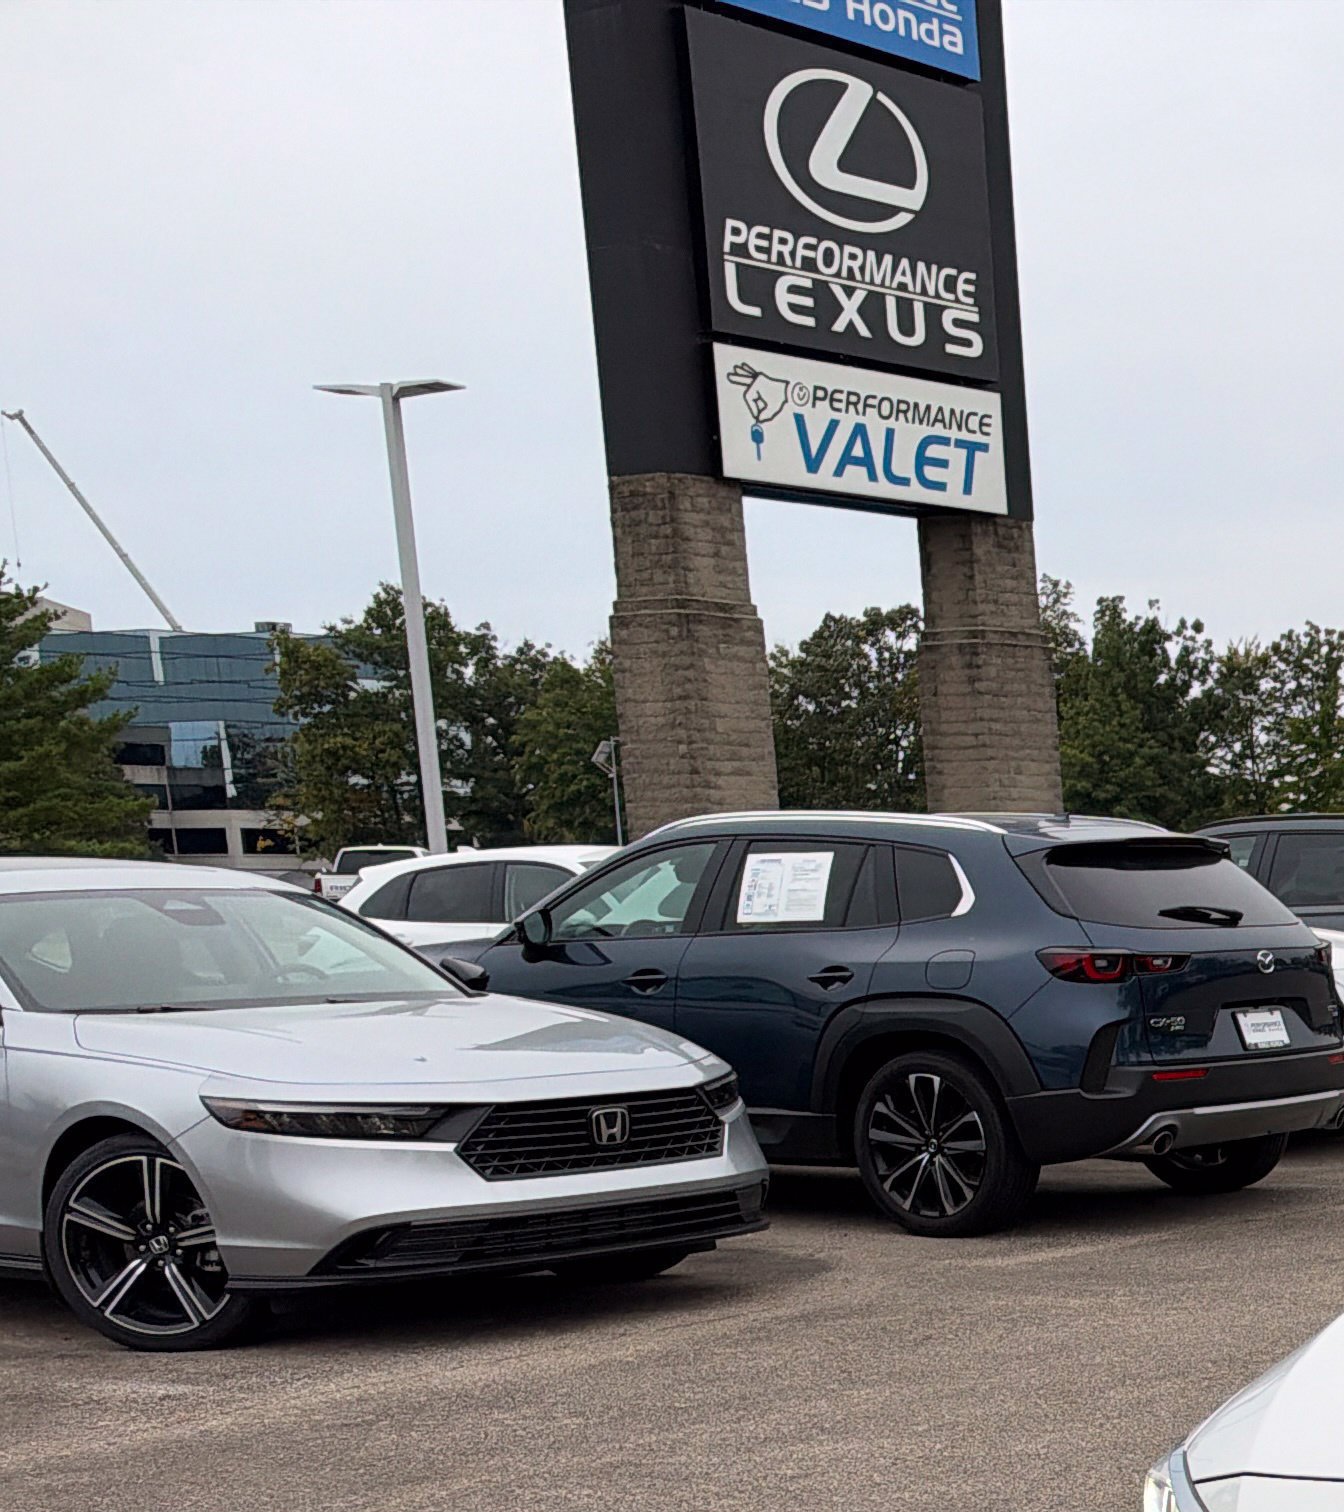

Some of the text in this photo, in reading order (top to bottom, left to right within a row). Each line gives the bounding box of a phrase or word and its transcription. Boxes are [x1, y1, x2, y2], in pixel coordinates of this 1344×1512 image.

[846, 0, 965, 56] Honda
[723, 217, 978, 305] PERFORMANCE
[723, 260, 984, 358] LEXUS
[811, 384, 993, 437] PERFORMANCE
[792, 411, 990, 496] VALET
